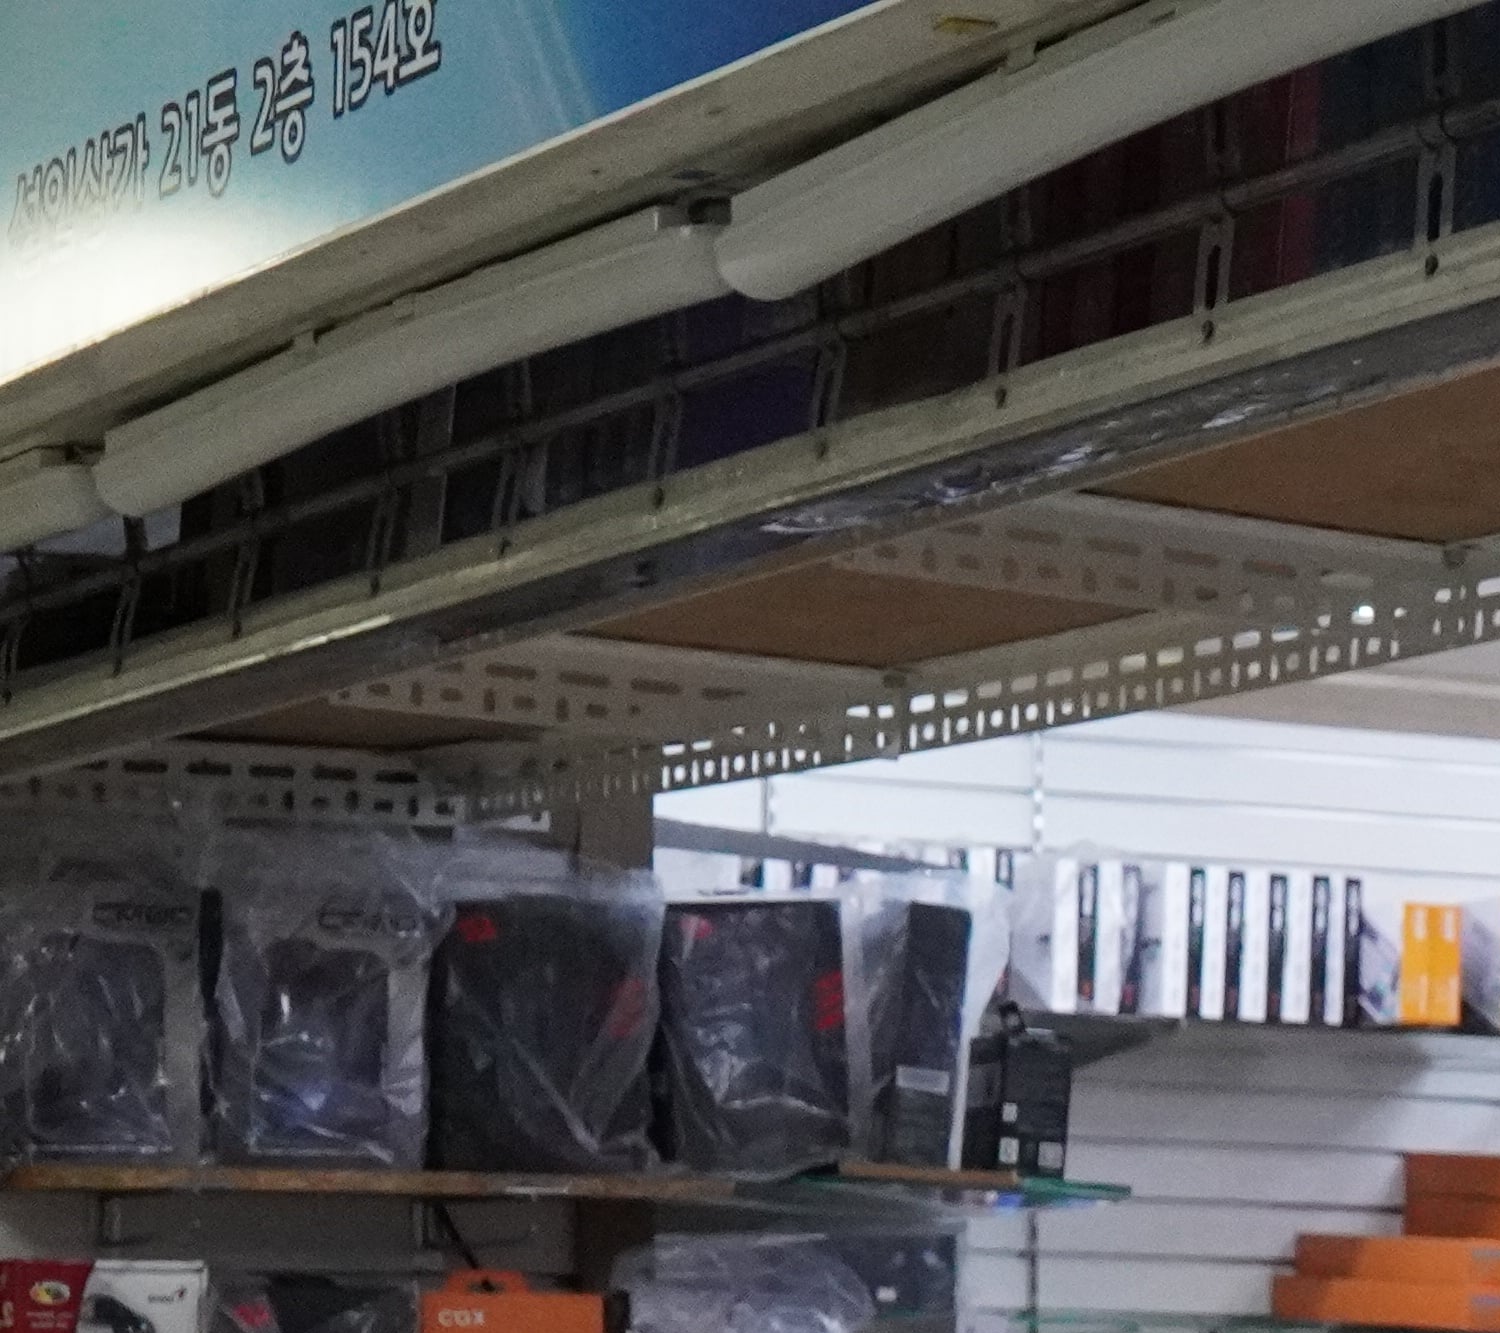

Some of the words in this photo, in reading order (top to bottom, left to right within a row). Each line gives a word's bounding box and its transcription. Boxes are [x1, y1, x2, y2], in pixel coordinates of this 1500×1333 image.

[160, 68, 239, 198] 21동
[251, 30, 315, 164] 2층
[330, 0, 441, 119] 154호
